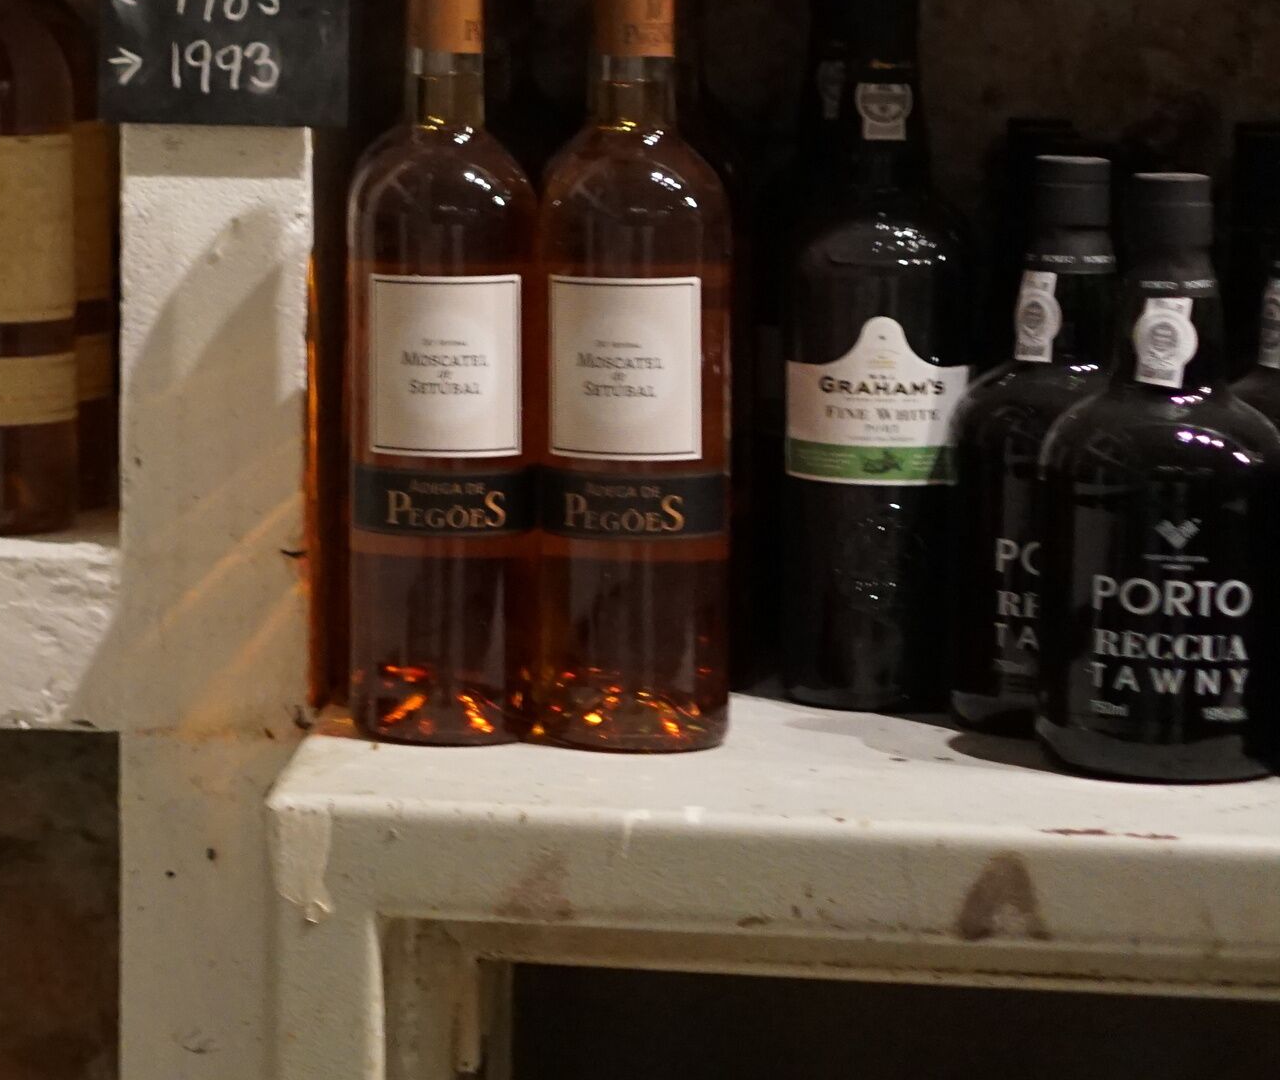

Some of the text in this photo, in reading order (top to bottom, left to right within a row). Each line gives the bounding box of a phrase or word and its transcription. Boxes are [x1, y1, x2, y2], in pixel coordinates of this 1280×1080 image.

[170, 38, 280, 95] 1993
[399, 350, 490, 368] MOSCATEL
[576, 352, 664, 370] MOSCATEL
[817, 375, 947, 396] GRAHAM'S
[824, 404, 942, 422] FINE WHITE
[1091, 574, 1255, 619] PORTO
[1092, 627, 1251, 663] RECCUA
[1089, 660, 1252, 696] TAWNY
